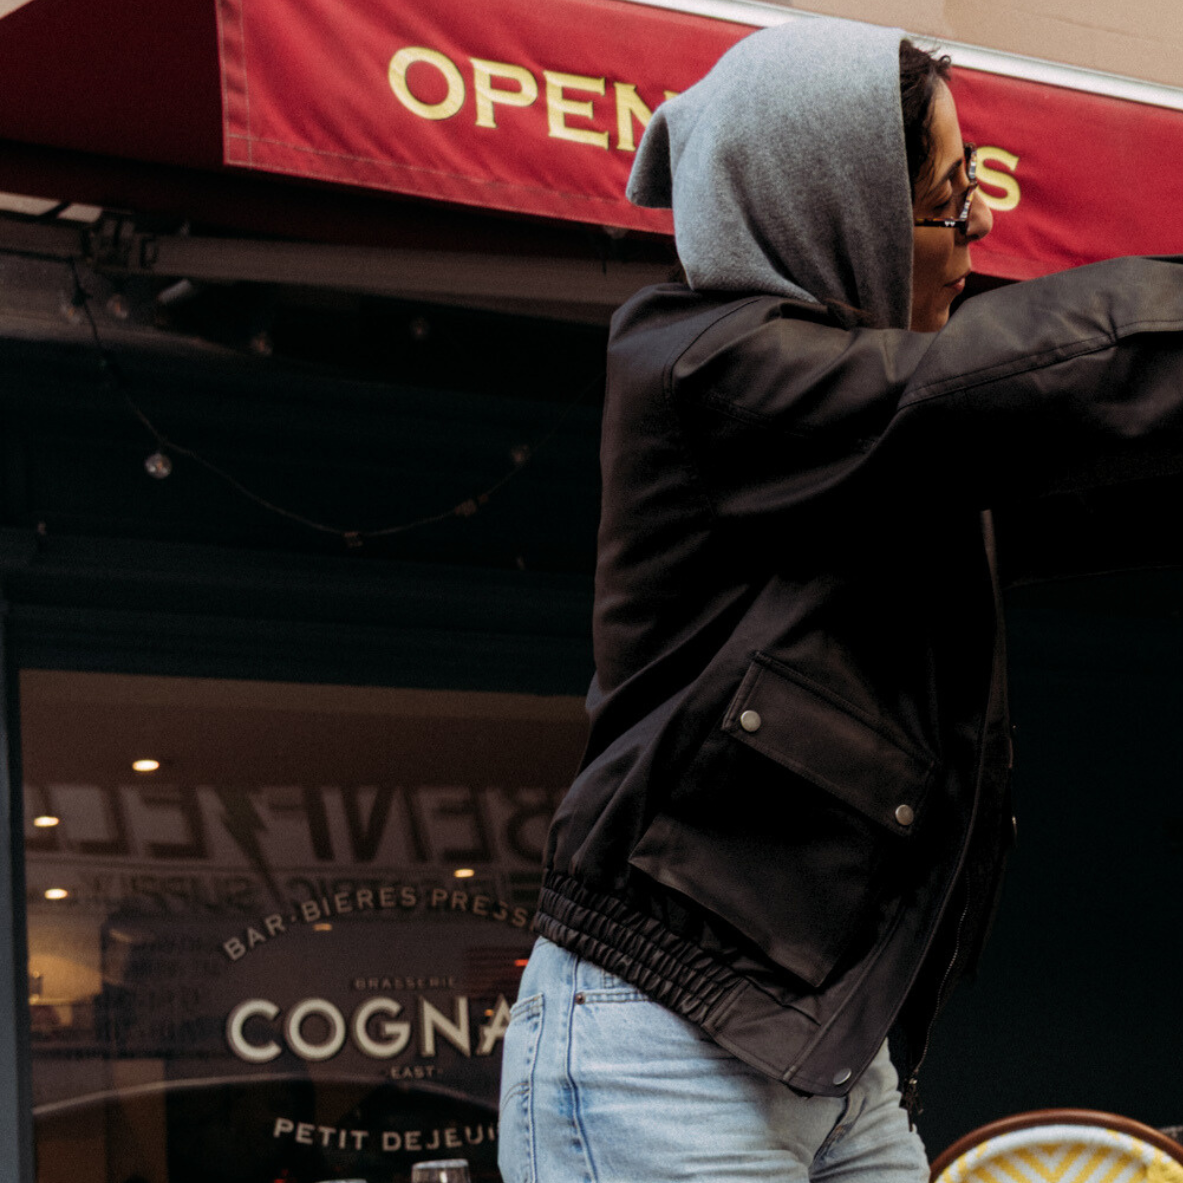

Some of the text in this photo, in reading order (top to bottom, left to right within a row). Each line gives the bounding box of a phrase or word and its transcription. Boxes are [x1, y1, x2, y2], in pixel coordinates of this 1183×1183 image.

[223, 886, 536, 961] BAR BIERES PRESS
[273, 1117, 370, 1150] PETIT
